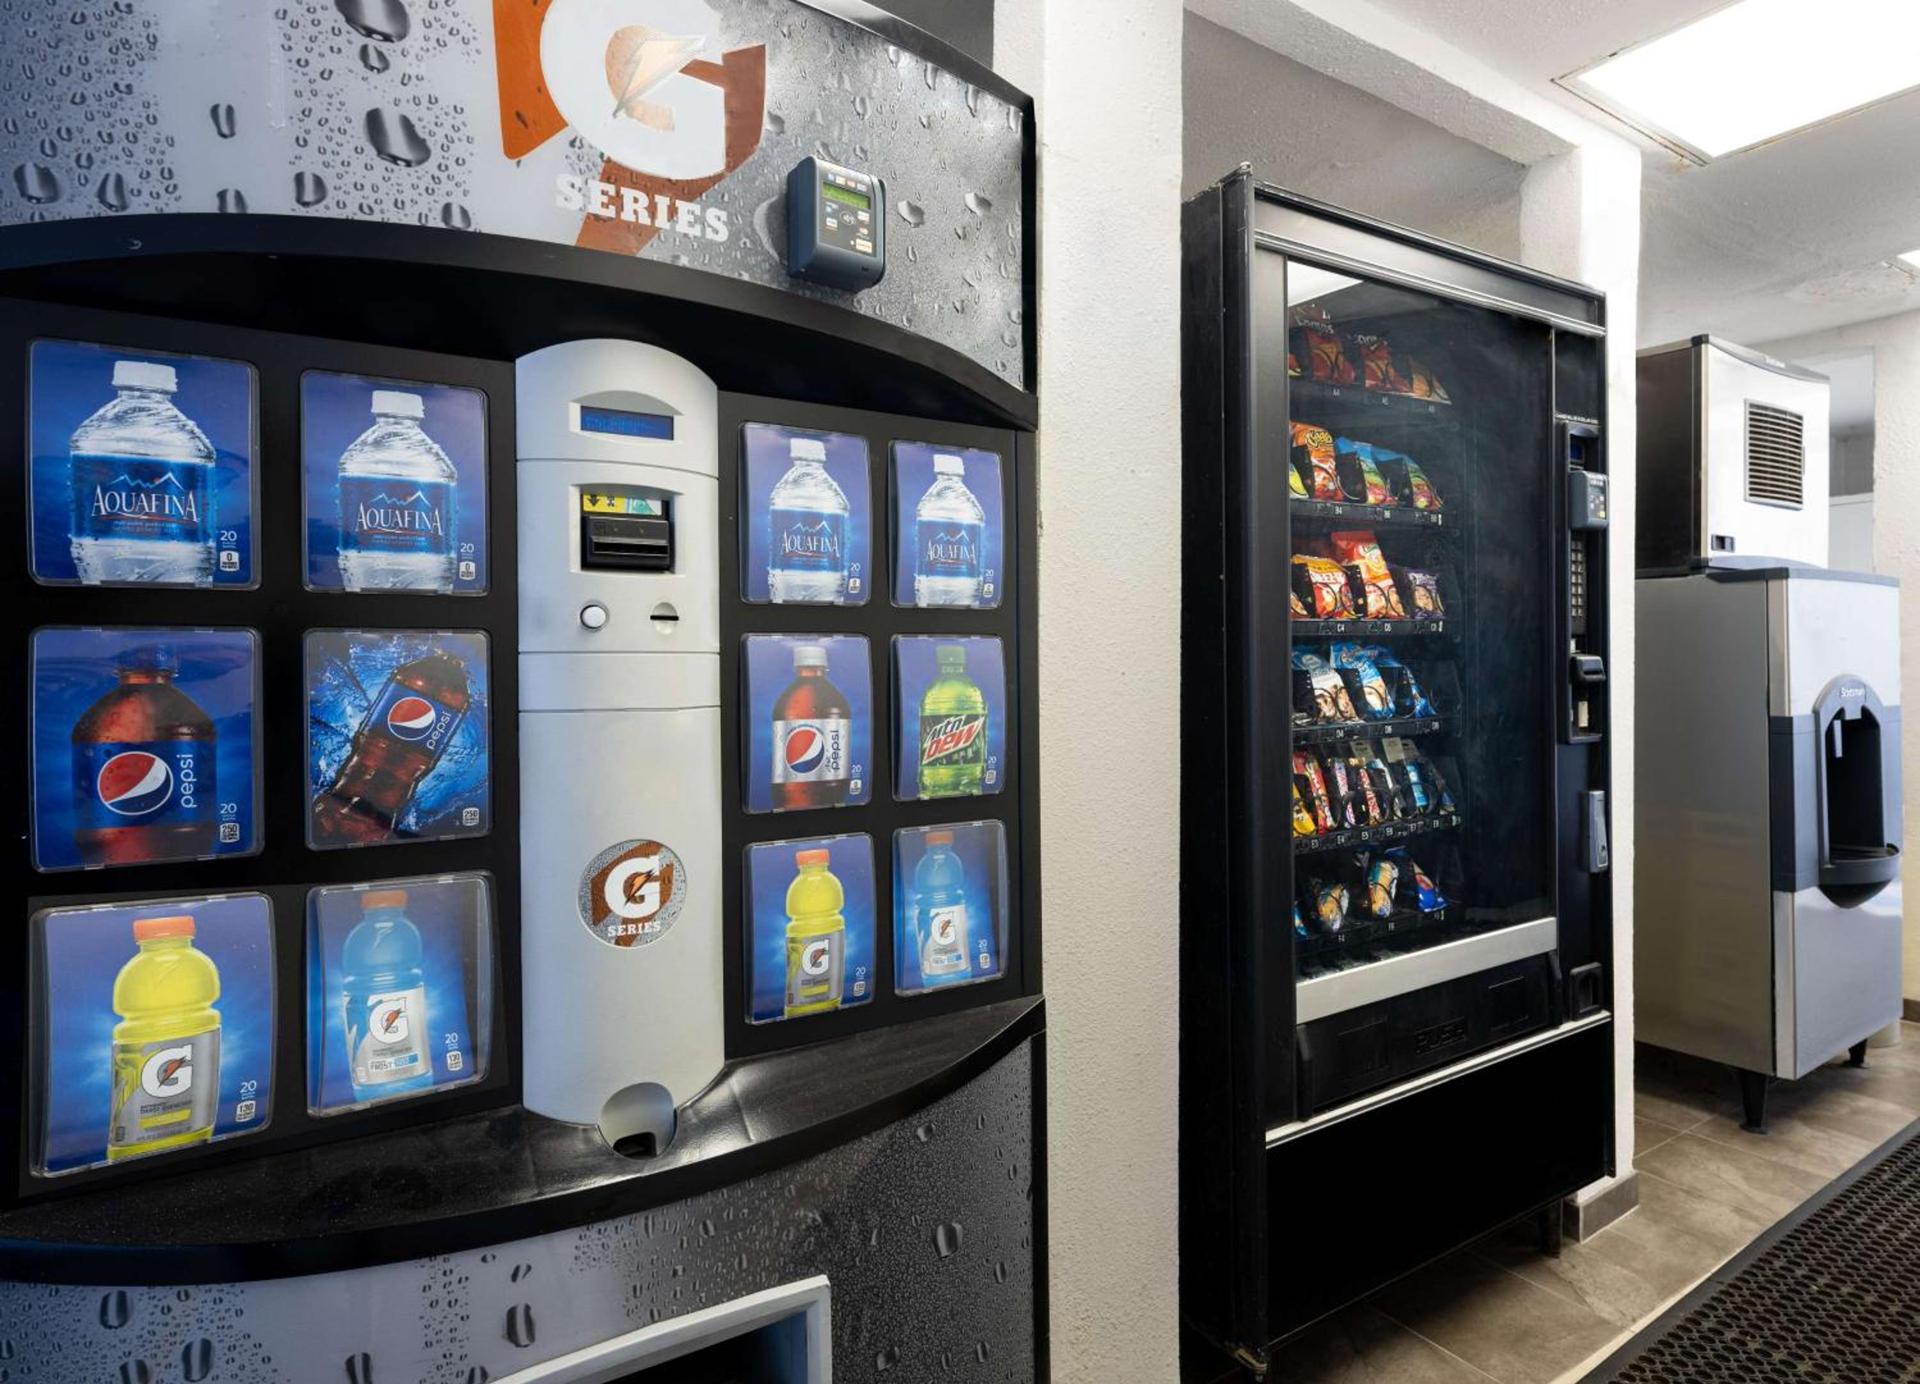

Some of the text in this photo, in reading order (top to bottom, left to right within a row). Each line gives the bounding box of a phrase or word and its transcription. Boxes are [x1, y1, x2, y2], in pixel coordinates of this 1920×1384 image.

[556, 173, 729, 242] SERIES
[91, 484, 199, 523] AQUAFINA
[355, 501, 444, 536] AQUAFINA
[220, 530, 237, 542] 20
[460, 542, 475, 553] 20
[780, 528, 840, 558] AQUAFINA
[926, 539, 977, 565] AQUAFINA
[426, 711, 452, 750] pepsi
[830, 729, 841, 770] pepsi
[176, 754, 198, 809] pepsi
[220, 803, 237, 814] 20
[604, 855, 660, 919] G
[607, 920, 661, 937] SERIES
[802, 939, 830, 975] G
[369, 997, 409, 1044] G
[445, 1032, 459, 1044] 20
[142, 1043, 193, 1098] G
[240, 1080, 257, 1093] 20
